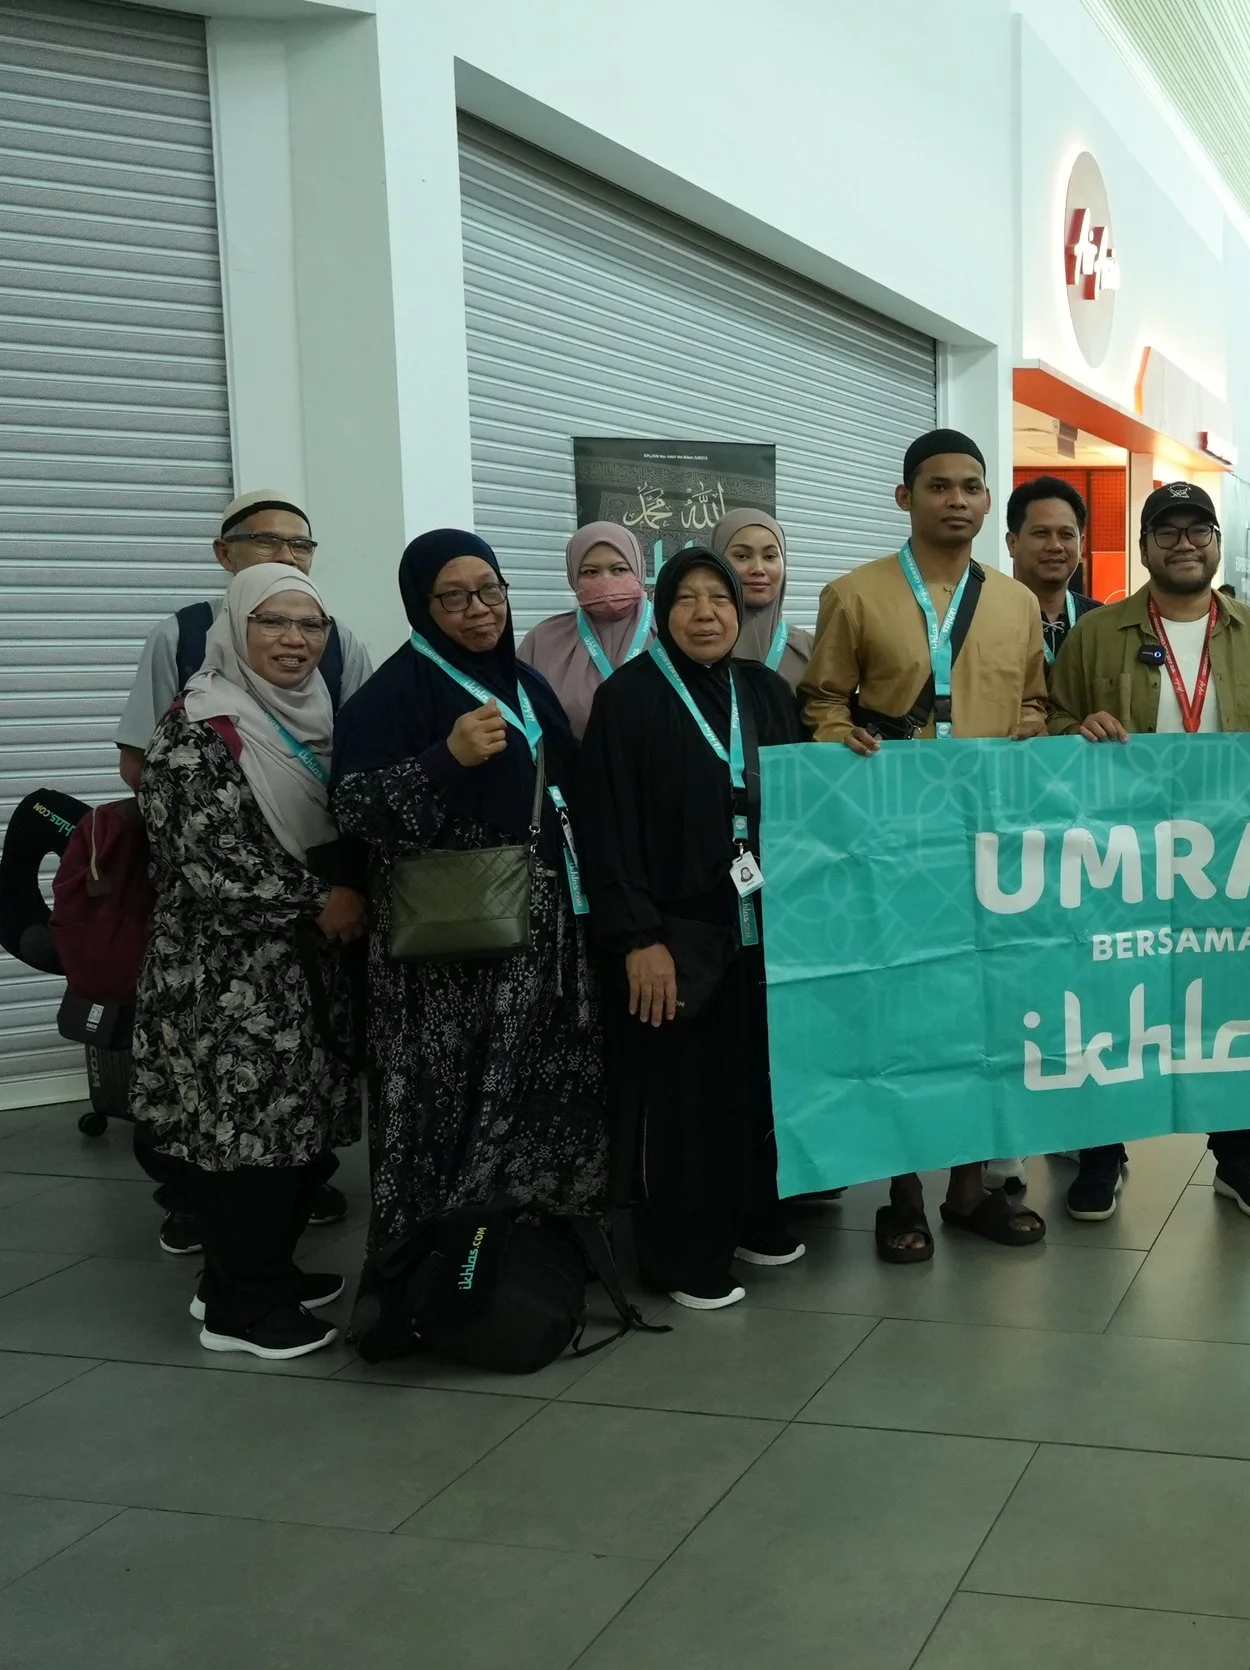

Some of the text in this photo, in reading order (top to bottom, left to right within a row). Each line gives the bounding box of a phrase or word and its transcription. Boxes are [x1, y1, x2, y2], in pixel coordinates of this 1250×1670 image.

[463, 679, 490, 703] ikhla
[299, 750, 324, 780] ikhlas
[31, 801, 77, 838] hlas.COM
